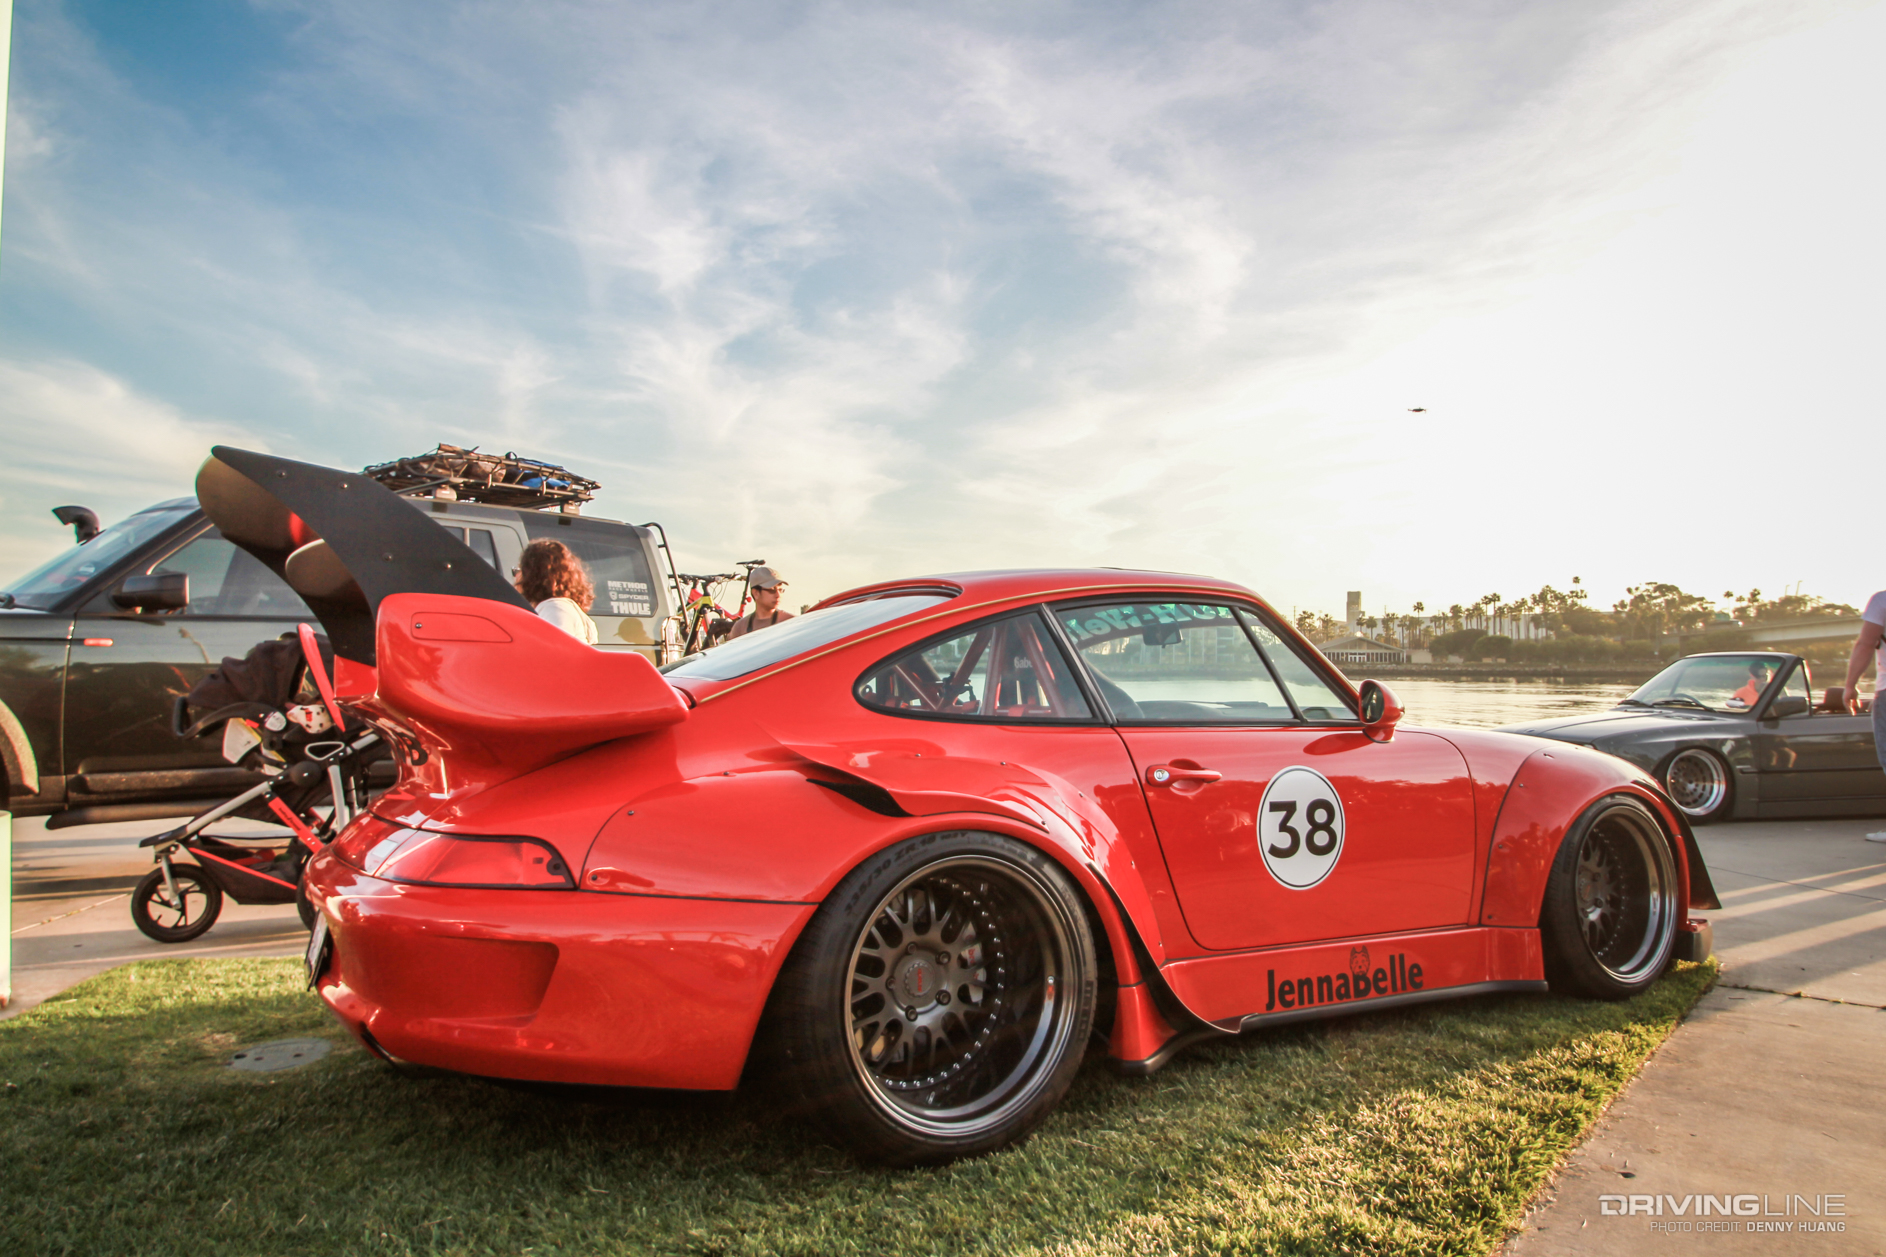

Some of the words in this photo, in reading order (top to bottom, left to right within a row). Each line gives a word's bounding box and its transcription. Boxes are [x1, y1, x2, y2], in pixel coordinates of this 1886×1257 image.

[607, 580, 647, 590] METHOD
[610, 601, 651, 615] THULE
[1267, 798, 1338, 859] 38
